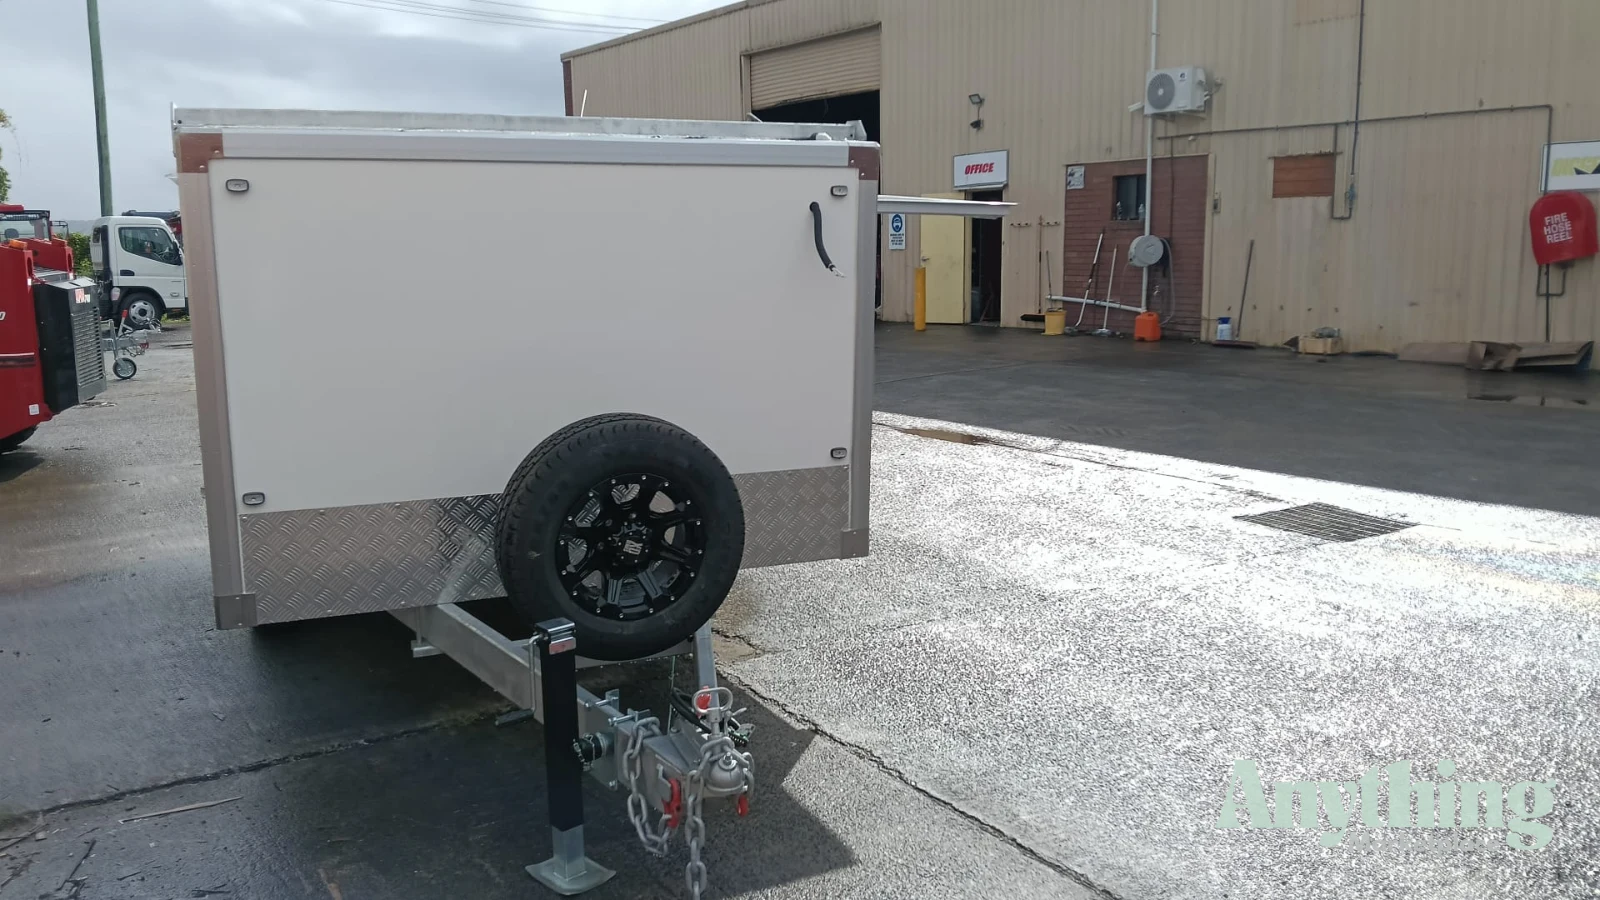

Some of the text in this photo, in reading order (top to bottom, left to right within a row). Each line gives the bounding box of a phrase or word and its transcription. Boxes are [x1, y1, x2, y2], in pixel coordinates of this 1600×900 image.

[964, 162, 995, 175] OFFICE
[1544, 212, 1568, 225] FIRE
[1543, 221, 1572, 235] HOSE
[1546, 231, 1573, 244] REEL
